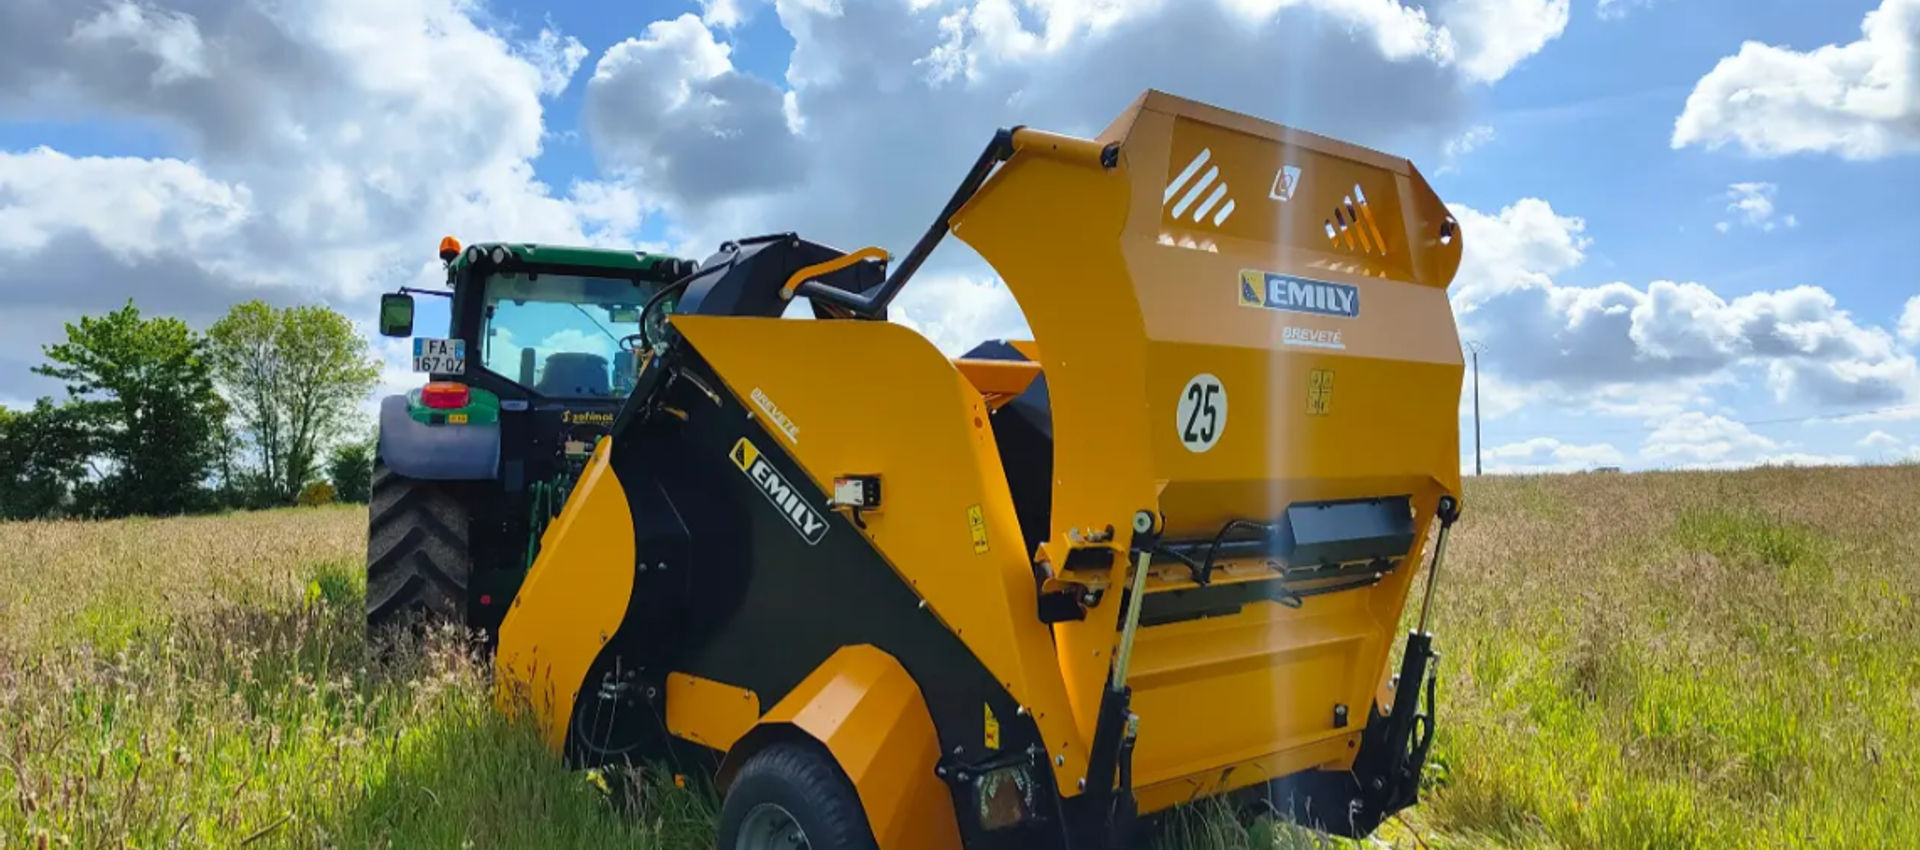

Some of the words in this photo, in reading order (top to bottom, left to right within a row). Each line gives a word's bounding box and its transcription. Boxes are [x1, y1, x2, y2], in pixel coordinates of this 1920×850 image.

[1269, 279, 1353, 313] EMILY
[1184, 383, 1219, 443] 25
[751, 459, 823, 535] EMILY
